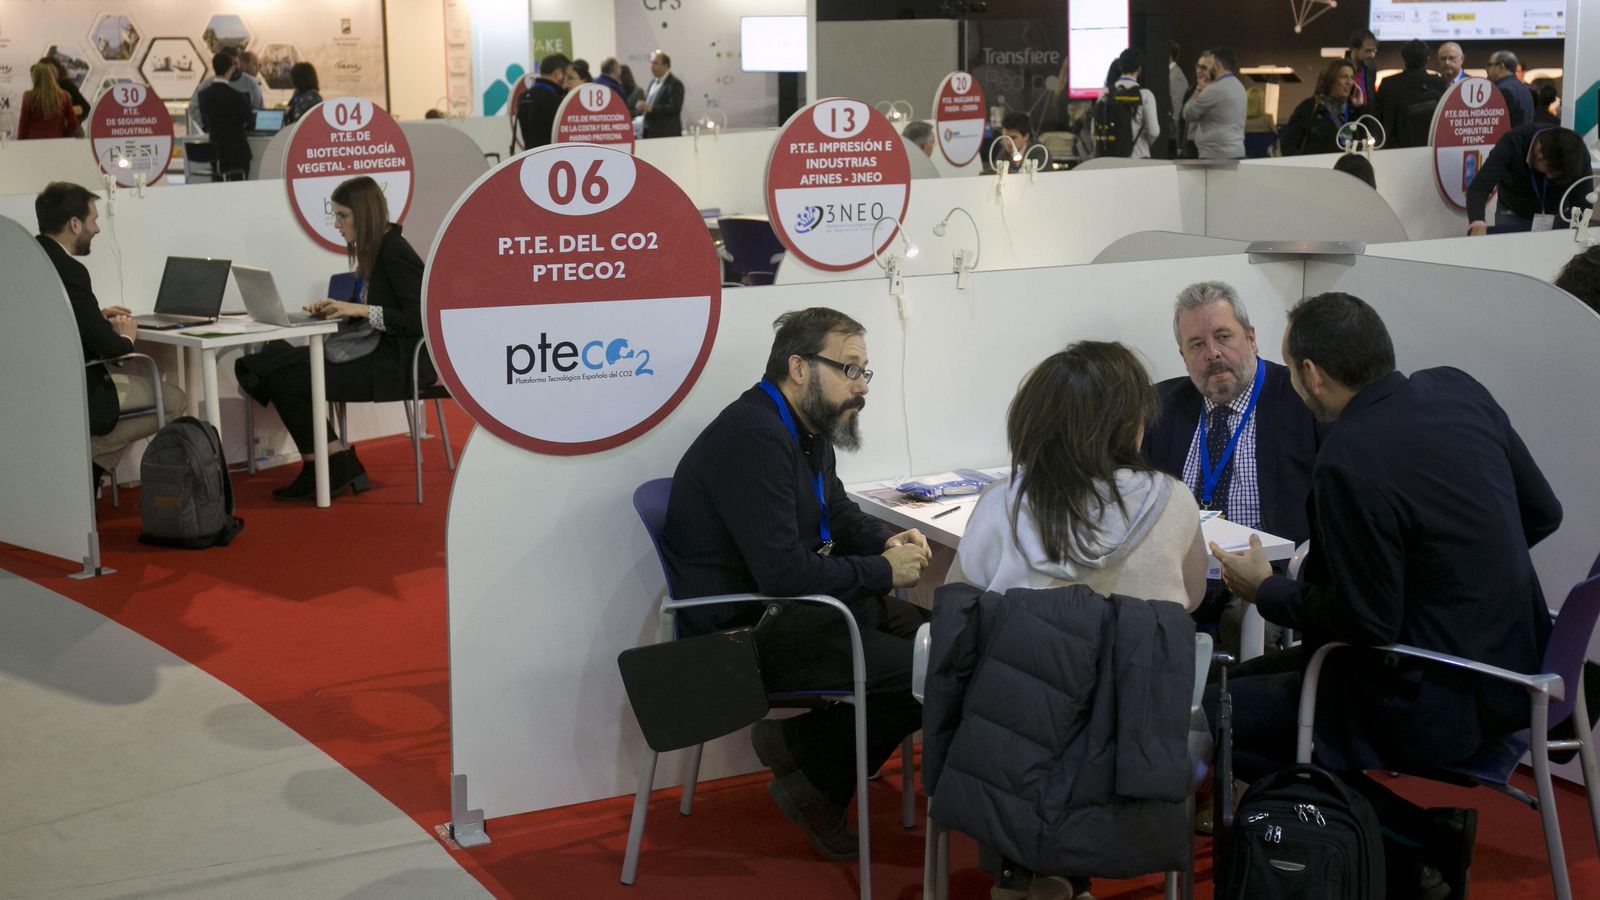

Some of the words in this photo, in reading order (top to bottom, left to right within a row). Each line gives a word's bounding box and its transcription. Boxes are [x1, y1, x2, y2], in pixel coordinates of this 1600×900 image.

[982, 47, 1060, 65] Transfiere
[956, 76, 968, 91] 20
[121, 87, 139, 104] 30
[589, 89, 604, 107] 18
[1470, 83, 1484, 104] 16
[124, 108, 140, 116] P.T.E.
[335, 102, 363, 126] 04
[1458, 109, 1470, 118] DEL
[1470, 107, 1505, 118] HIDRÓGENO
[106, 119, 117, 127] DE
[118, 117, 158, 126] SEGURIDAD
[831, 107, 856, 133] 13
[1455, 119, 1463, 127] DE
[1463, 118, 1475, 126] LAS
[1474, 117, 1491, 126] PILAS
[1491, 117, 1500, 125] DE
[111, 128, 154, 136] INDUSTRIAL
[560, 125, 569, 133] DE
[1454, 127, 1494, 136] COMBUSTIBLE
[330, 132, 355, 143] P.T.E.
[356, 131, 371, 141] DE
[1462, 135, 1486, 144] PTEHPC
[306, 142, 396, 159] BIOTECNOLOGÍA
[789, 142, 818, 154] P.T.E.
[819, 138, 883, 153] IMPRESIÓN
[884, 140, 893, 151] E
[297, 161, 346, 174] VEGETAL
[353, 157, 406, 170] BIOVEGEN
[806, 156, 877, 169] INDUSTRIAS
[548, 159, 609, 206] 06
[800, 173, 842, 185] AFINES
[851, 171, 883, 184] 3NEO
[826, 202, 884, 223] 3NEO
[498, 236, 554, 256] P.T.E.
[559, 233, 605, 253] DEL
[610, 231, 659, 251] CO2
[533, 260, 626, 283] PTECO2
[515, 377, 547, 385] Plataforma
[548, 374, 581, 384] Tecnológica
[581, 372, 608, 381] Española
[608, 370, 618, 379] del
[618, 370, 633, 378] CO2
